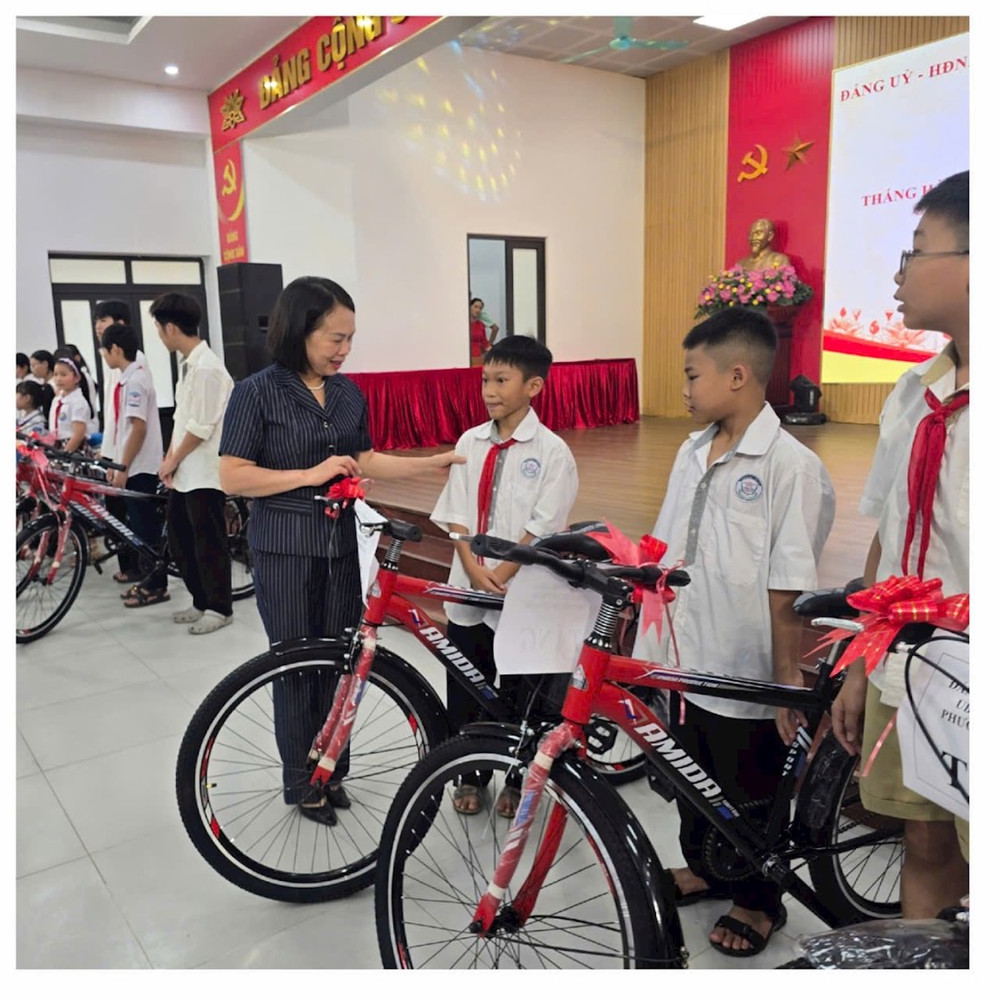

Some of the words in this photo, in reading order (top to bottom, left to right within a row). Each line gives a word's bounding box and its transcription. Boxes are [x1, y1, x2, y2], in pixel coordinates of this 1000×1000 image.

[259, 53, 313, 111] ĐẢNG
[840, 80, 885, 102] ĐẢNG
[929, 55, 969, 78] HĐN
[860, 186, 918, 207] THÁNG
[419, 625, 486, 684] AMIDA
[634, 722, 723, 799] AMIDA
